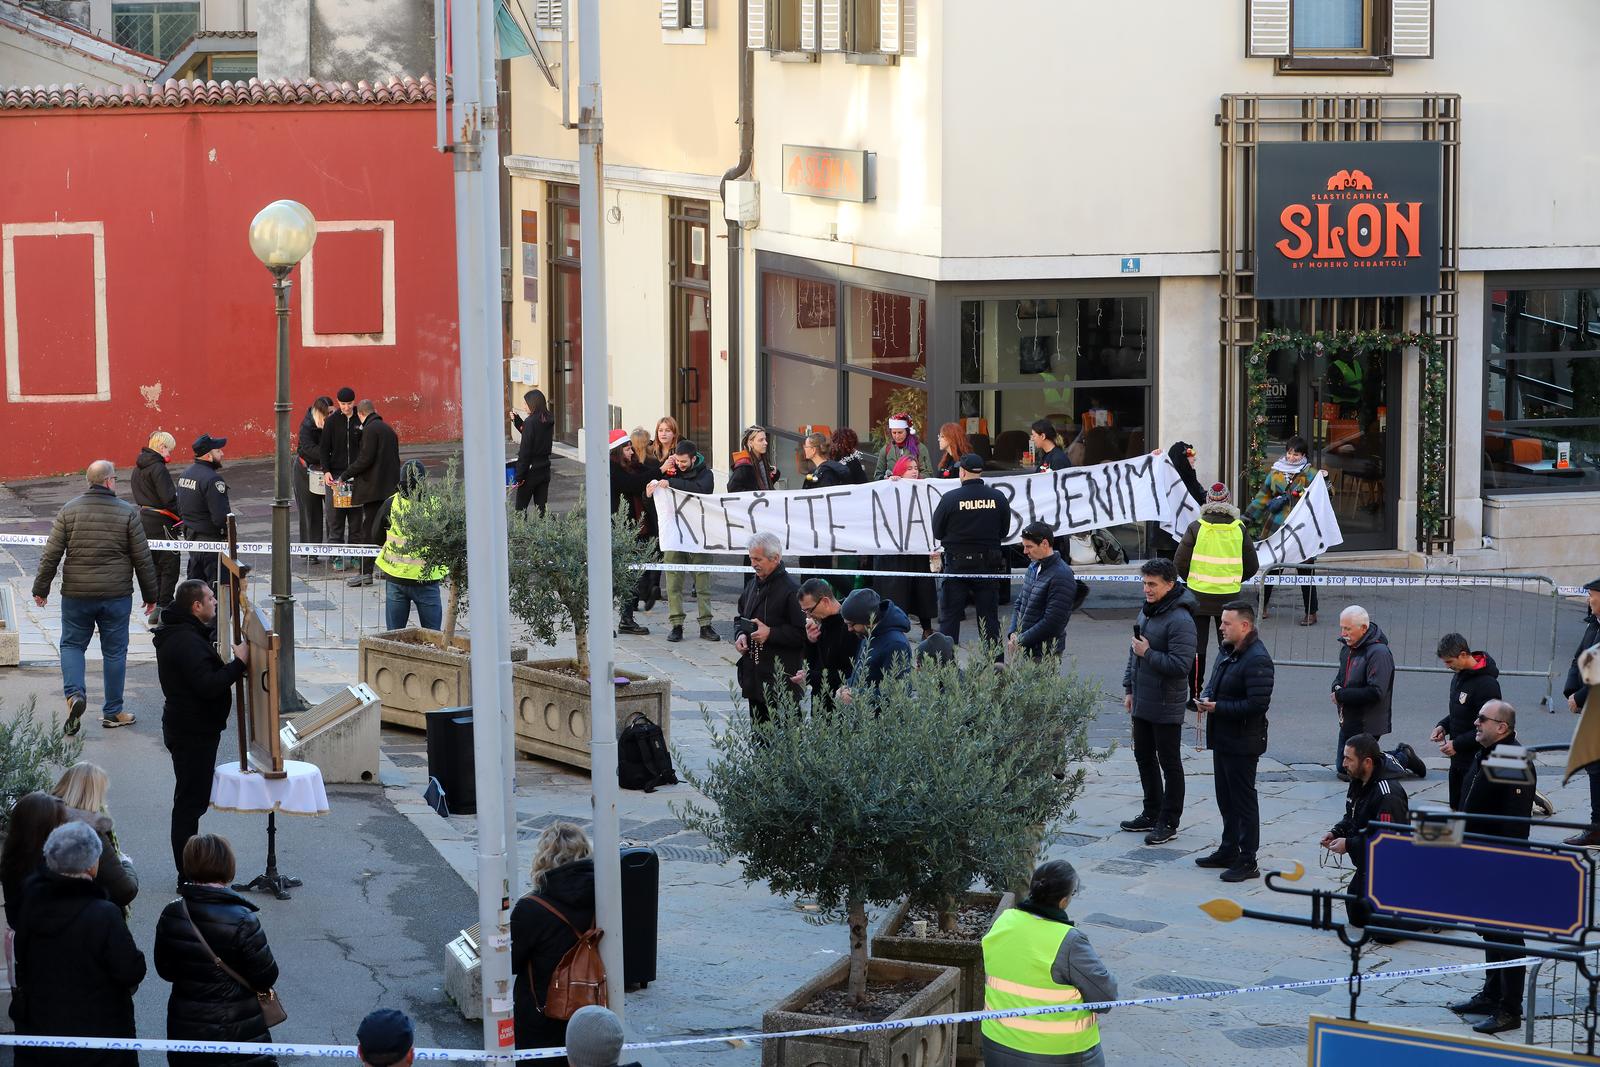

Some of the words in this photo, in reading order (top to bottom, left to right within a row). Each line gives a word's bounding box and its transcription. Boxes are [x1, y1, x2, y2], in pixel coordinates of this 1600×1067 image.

[1311, 192, 1389, 200] SLASTIČARNICA
[1275, 202, 1423, 259] SLON
[1127, 259, 1134, 268] 4
[959, 499, 996, 510] POLICIJA
[671, 491, 857, 553] KLEČITE
[0, 535, 28, 543] OLICIJA
